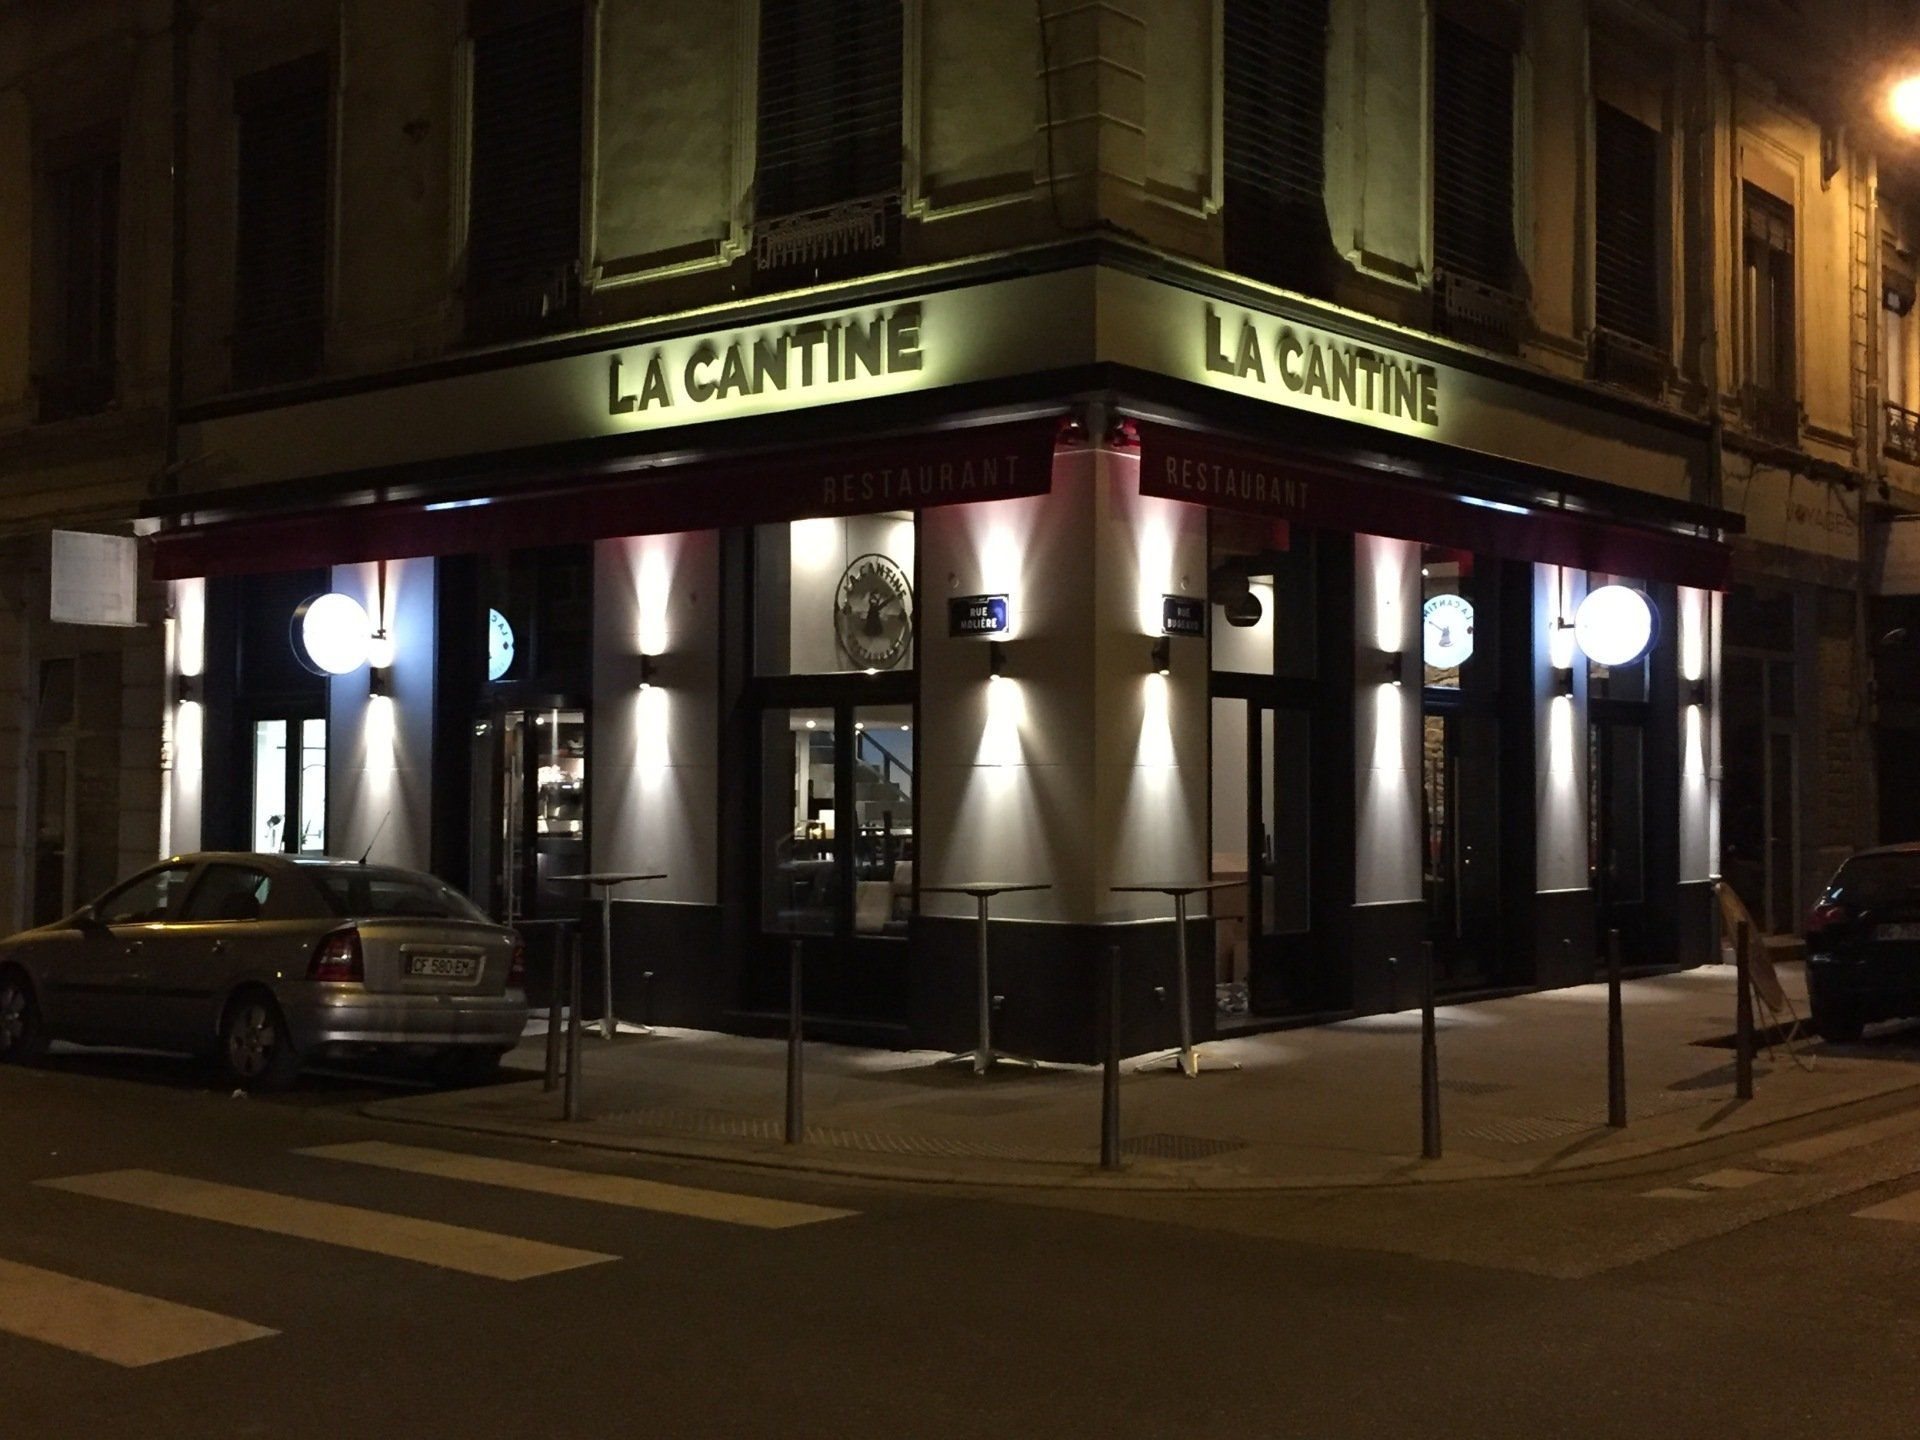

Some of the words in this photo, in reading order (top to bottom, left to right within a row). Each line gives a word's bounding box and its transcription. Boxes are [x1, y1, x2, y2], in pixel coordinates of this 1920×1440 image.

[609, 357, 673, 415] LA
[684, 302, 923, 403] CANTINE
[1206, 306, 1266, 383] LA
[1279, 335, 1439, 427] CANTINE
[823, 455, 1019, 505] RESTAURANT
[1166, 456, 1309, 509] RESTAURANT
[860, 561, 907, 600] CANTINE
[960, 617, 998, 629] MOLIÈRE
[970, 606, 988, 617] RUE
[414, 958, 429, 972] CF
